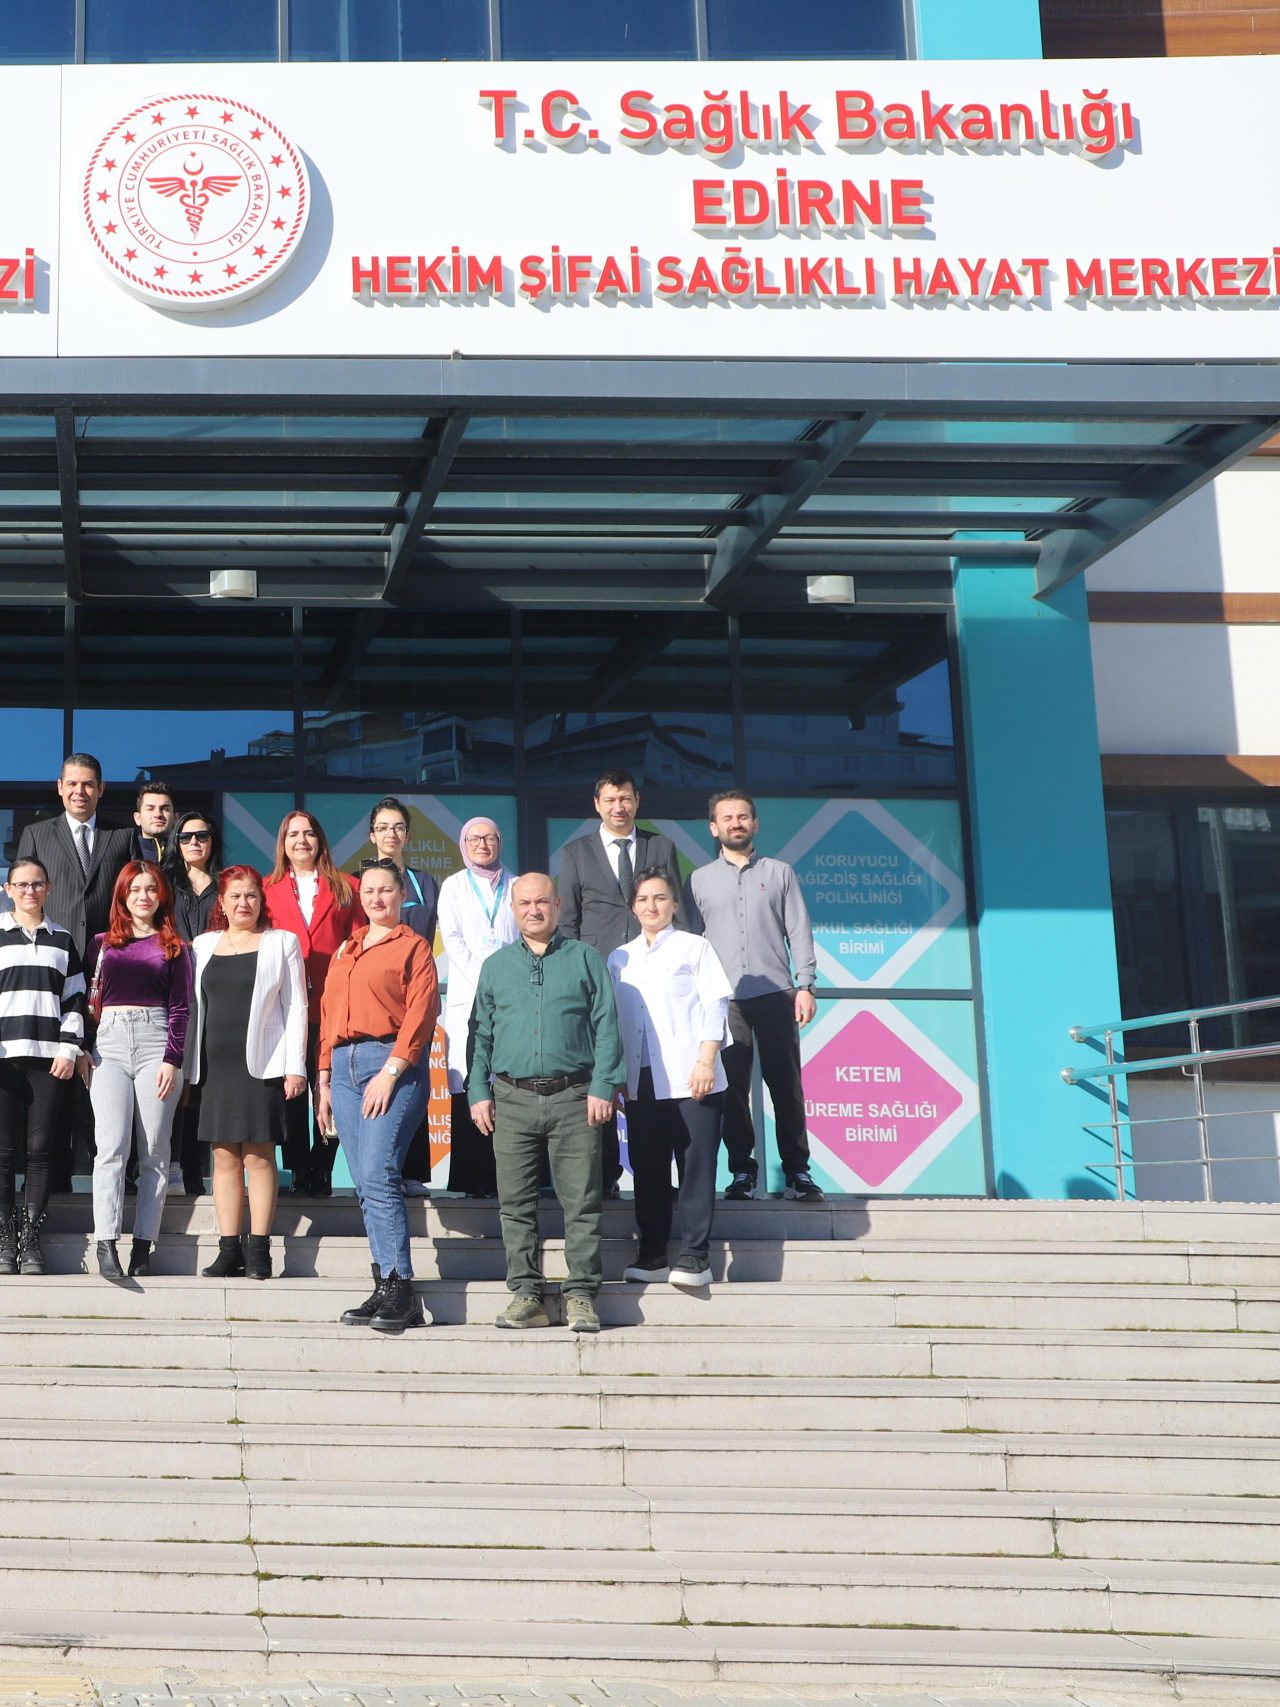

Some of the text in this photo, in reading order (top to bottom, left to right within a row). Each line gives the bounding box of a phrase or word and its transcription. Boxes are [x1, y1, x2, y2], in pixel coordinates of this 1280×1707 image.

[479, 88, 1134, 154] T.C. Sağlık Bakanlığı
[125, 129, 264, 249] TÜRKİYE CUMHURİYETİ SAĞLIK BAKANLIĞI
[693, 167, 926, 225] EDİRNE
[352, 245, 1280, 299] HEKİM ŞİFAİ SAĞLIKLI HAYAT MERKEZİ
[404, 841, 446, 852] LIKLI
[410, 857, 452, 869] ENME
[815, 855, 898, 867] KORUYUCU
[862, 871, 921, 886] SAĞLIĞI
[815, 889, 903, 904] POLİKLİNİĞİ
[853, 920, 913, 934] SAĞLIĞI
[839, 940, 885, 954] BİRİMİ
[835, 1066, 901, 1082] KETEM
[804, 1100, 937, 1118] ÜREME SAĞLIĞI
[845, 1125, 898, 1142] BİRİMİ
